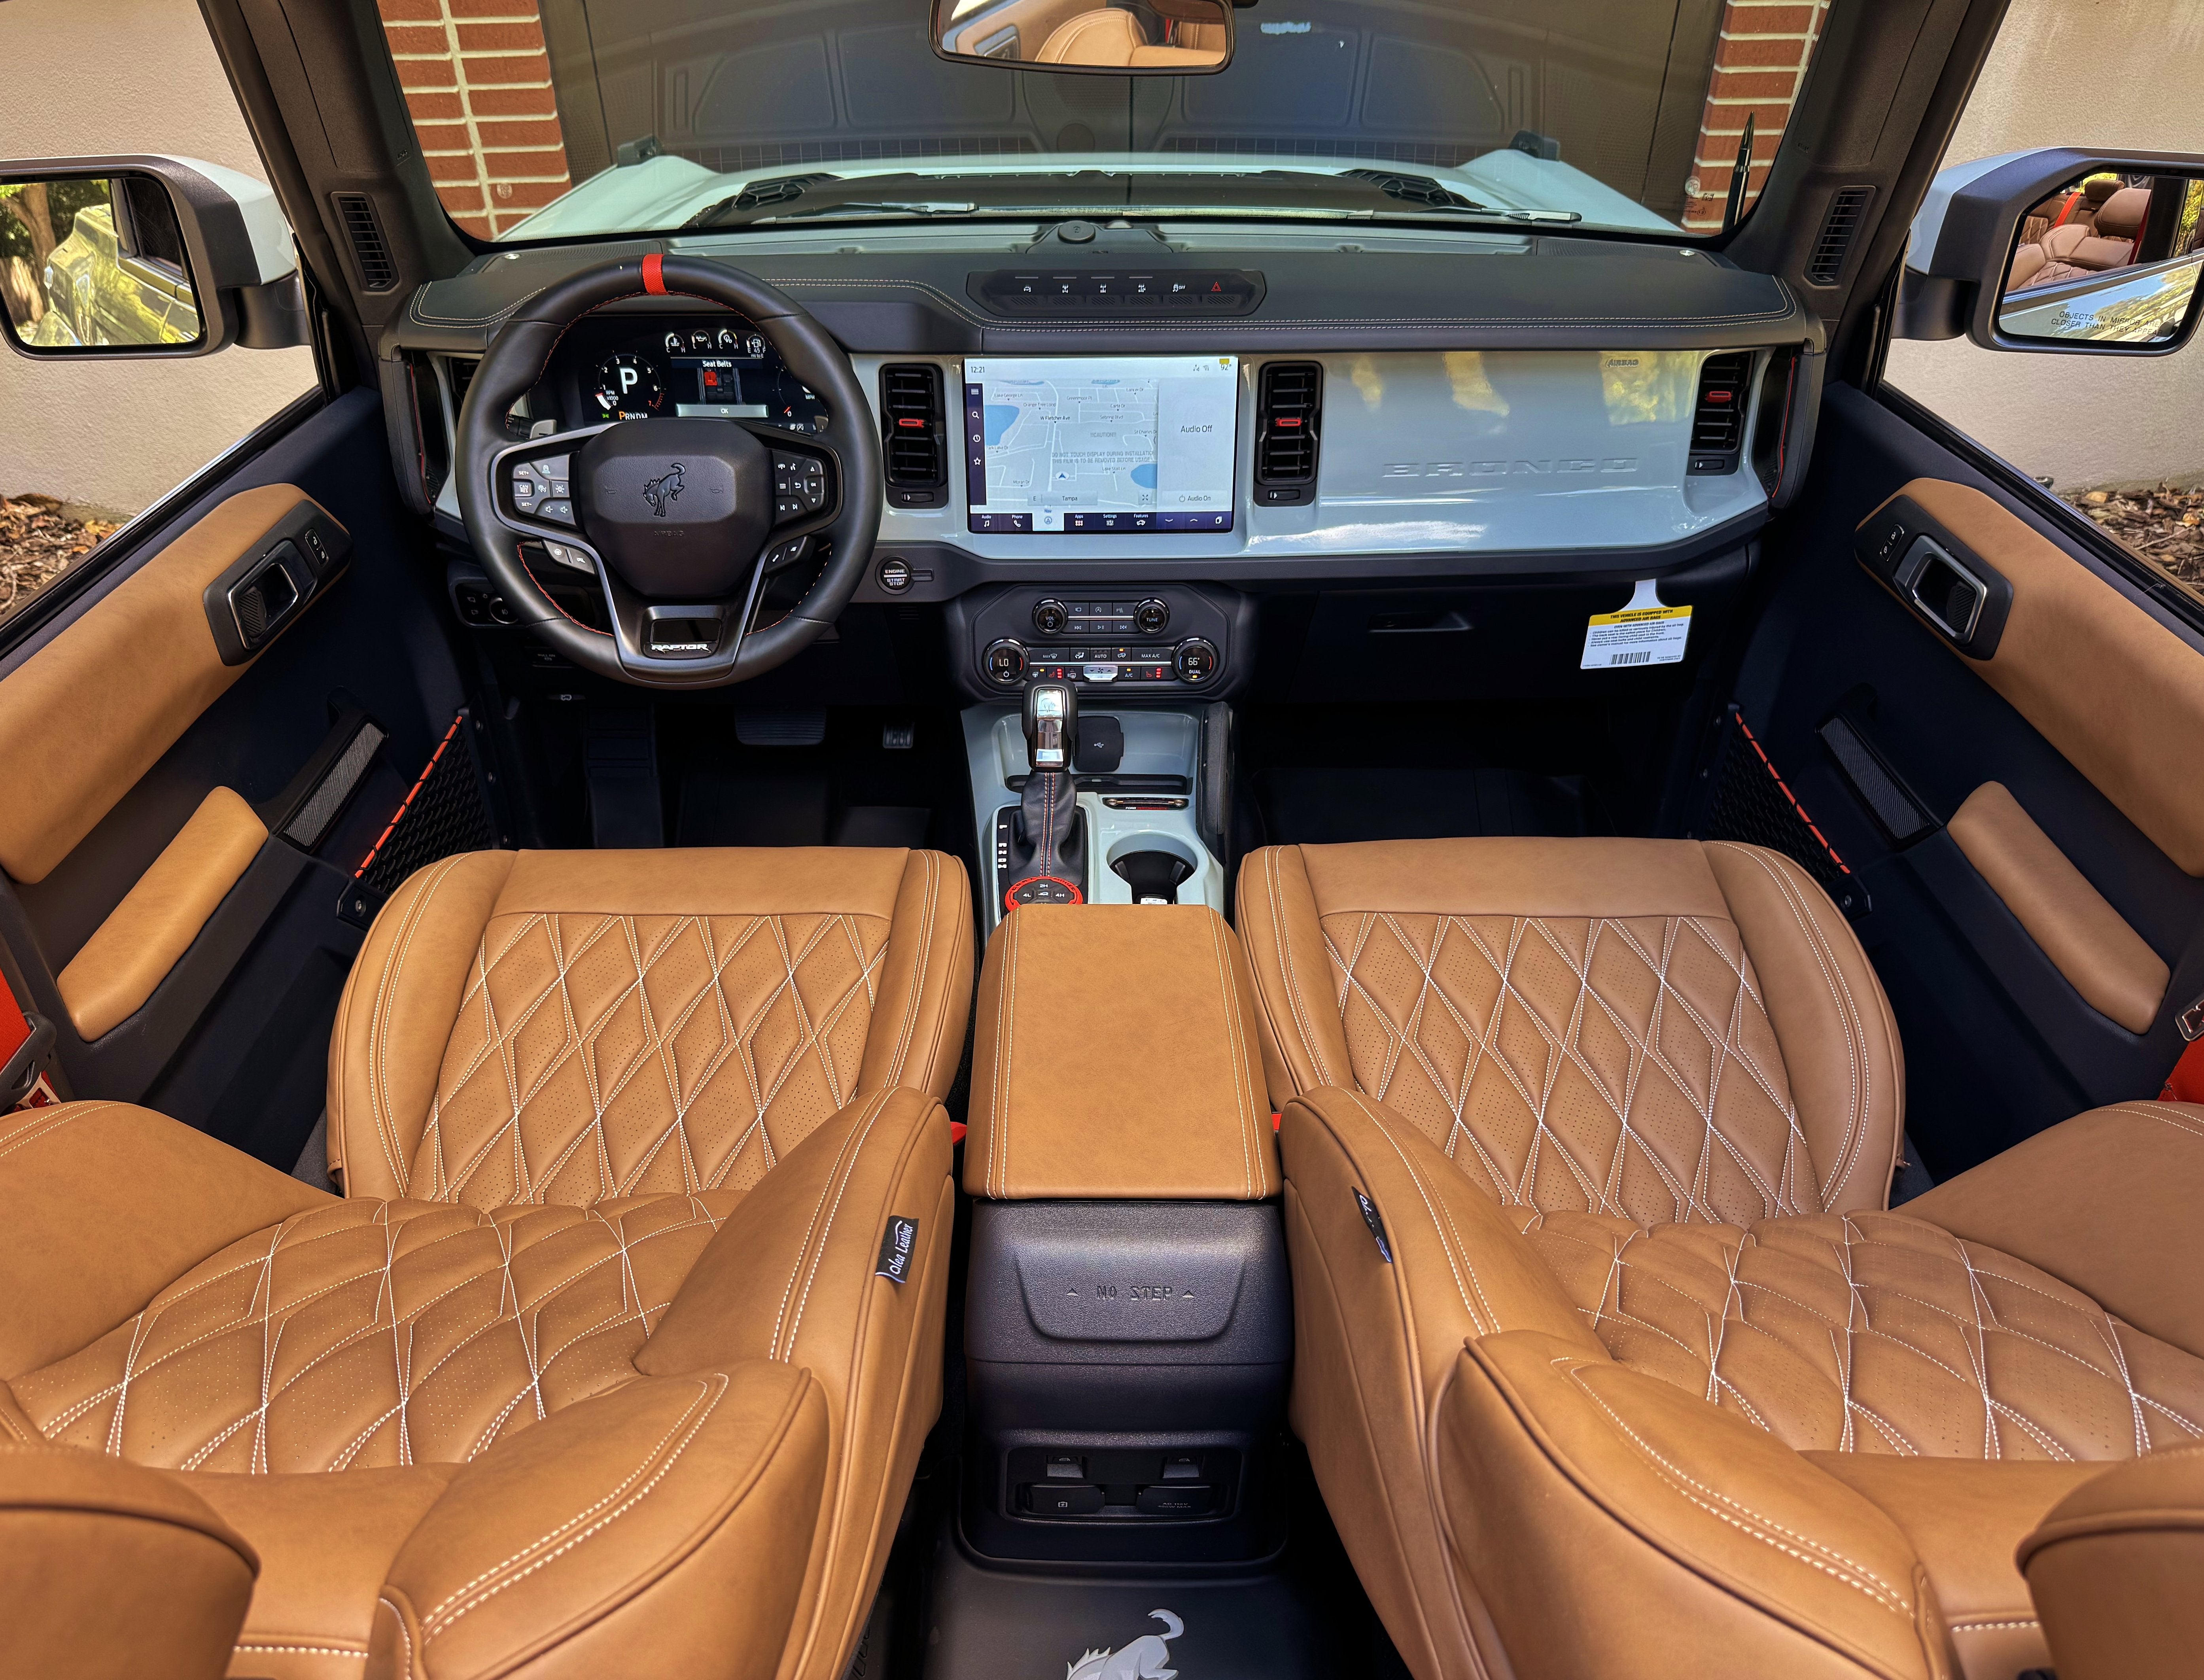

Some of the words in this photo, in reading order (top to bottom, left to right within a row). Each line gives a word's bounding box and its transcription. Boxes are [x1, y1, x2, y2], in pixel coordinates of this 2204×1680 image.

[2051, 318, 2081, 327] CLOSER
[2059, 311, 2094, 321] OBJECTS
[2110, 317, 2141, 325] MIRROR
[619, 367, 638, 394] P
[1382, 458, 1638, 477] BRONCO
[651, 643, 712, 654] RAPTOR
[999, 658, 1008, 667] LO
[895, 1223, 913, 1254] Leather
[1097, 1285, 1117, 1300] NO
[1130, 1285, 1173, 1301] STEP
